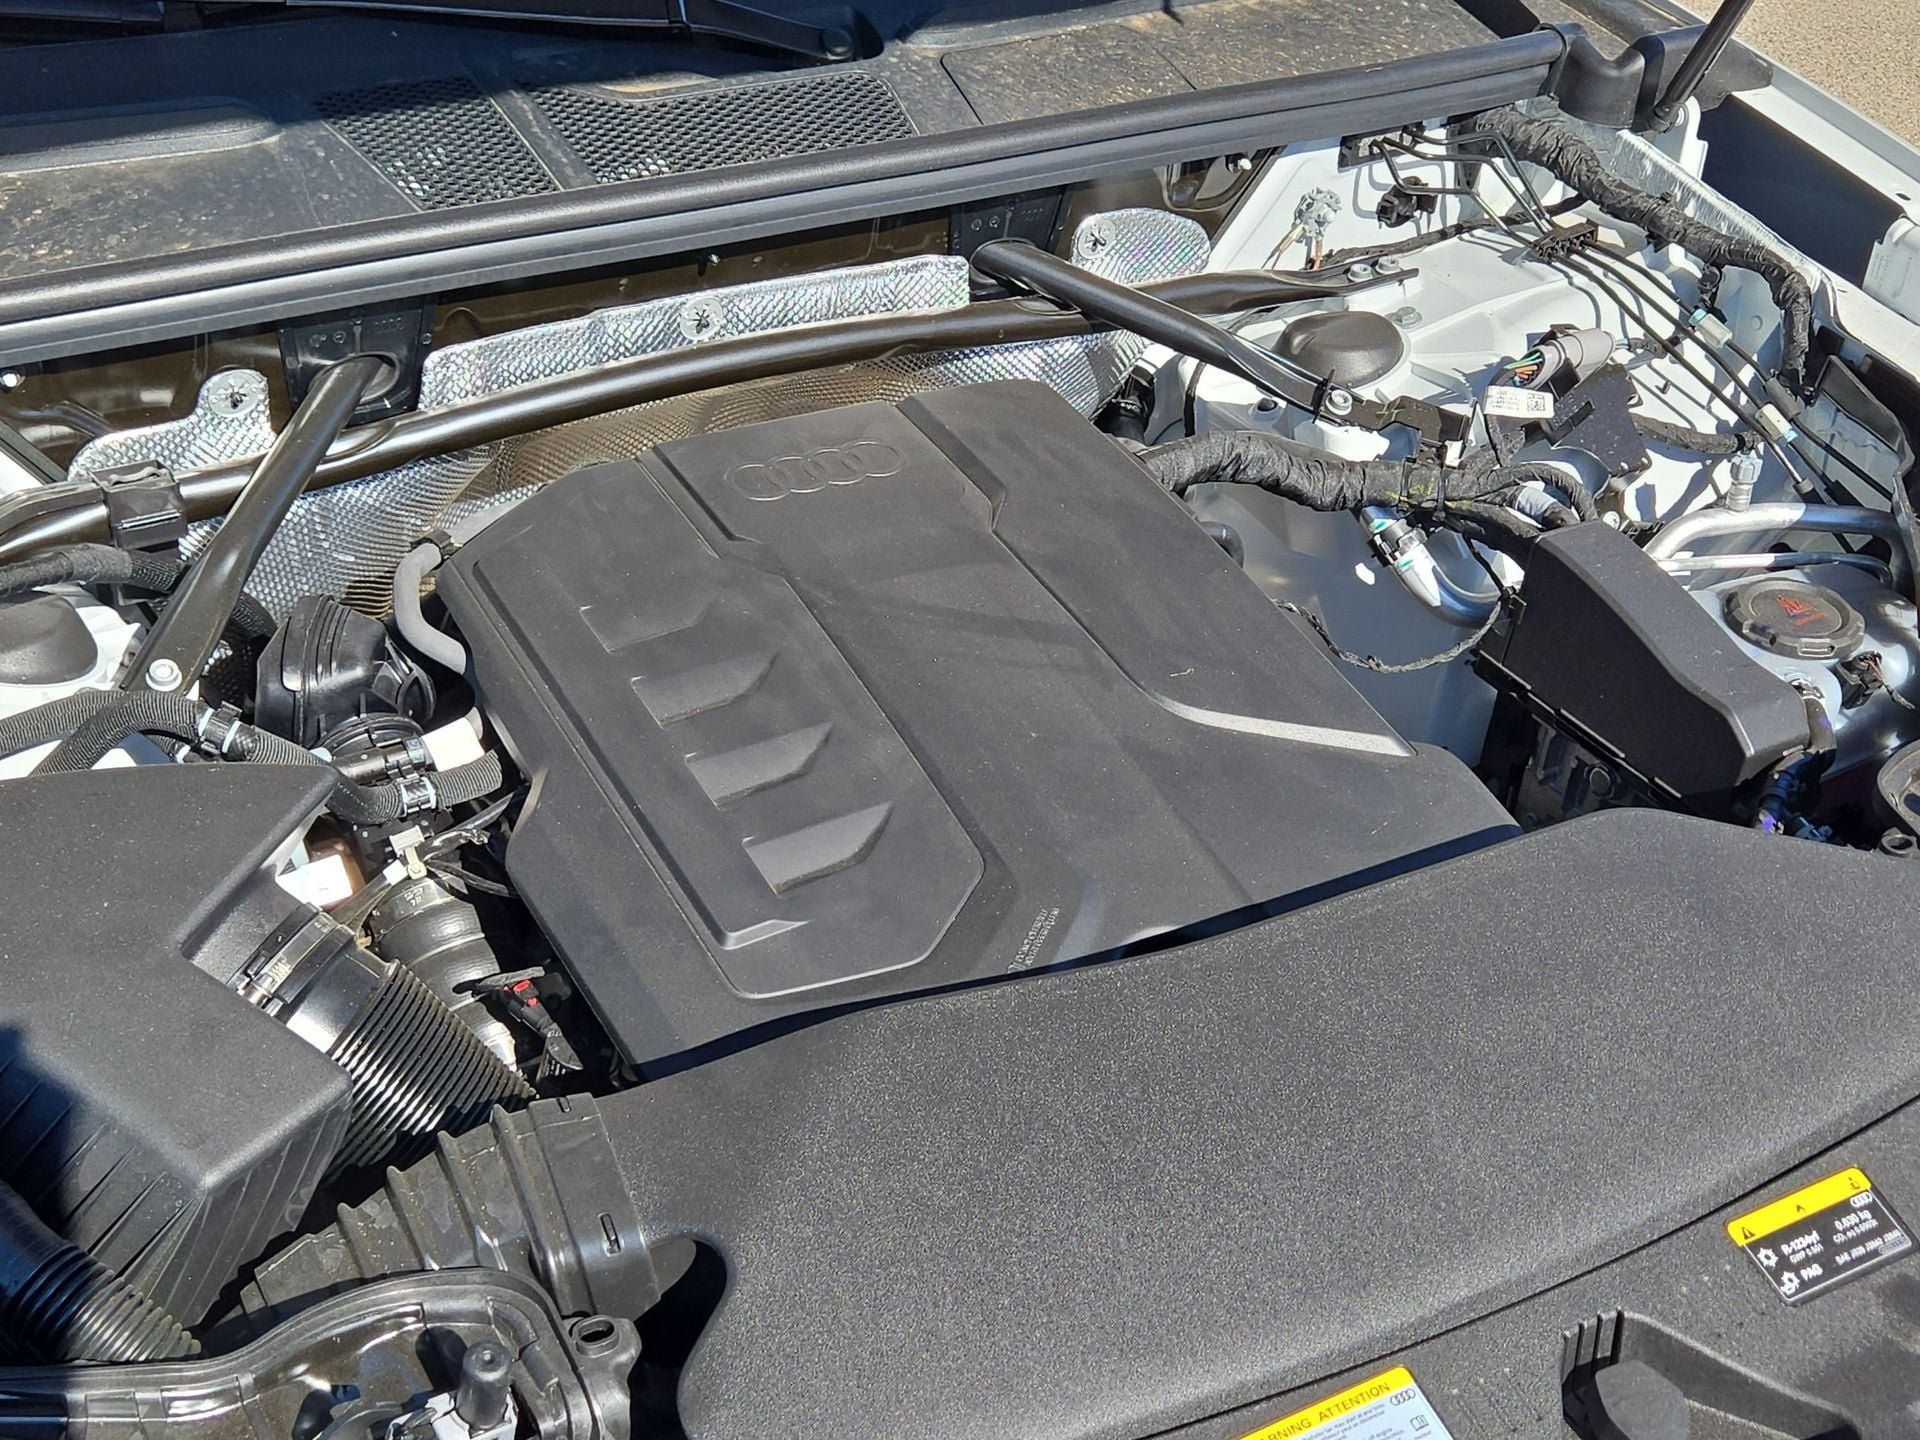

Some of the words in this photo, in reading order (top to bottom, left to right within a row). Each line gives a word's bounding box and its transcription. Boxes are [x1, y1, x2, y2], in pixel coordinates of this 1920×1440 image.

[1857, 1209, 1873, 1221] kg
[1260, 1418, 1312, 1440] RNING
[1318, 1382, 1390, 1422] ATTENTION
